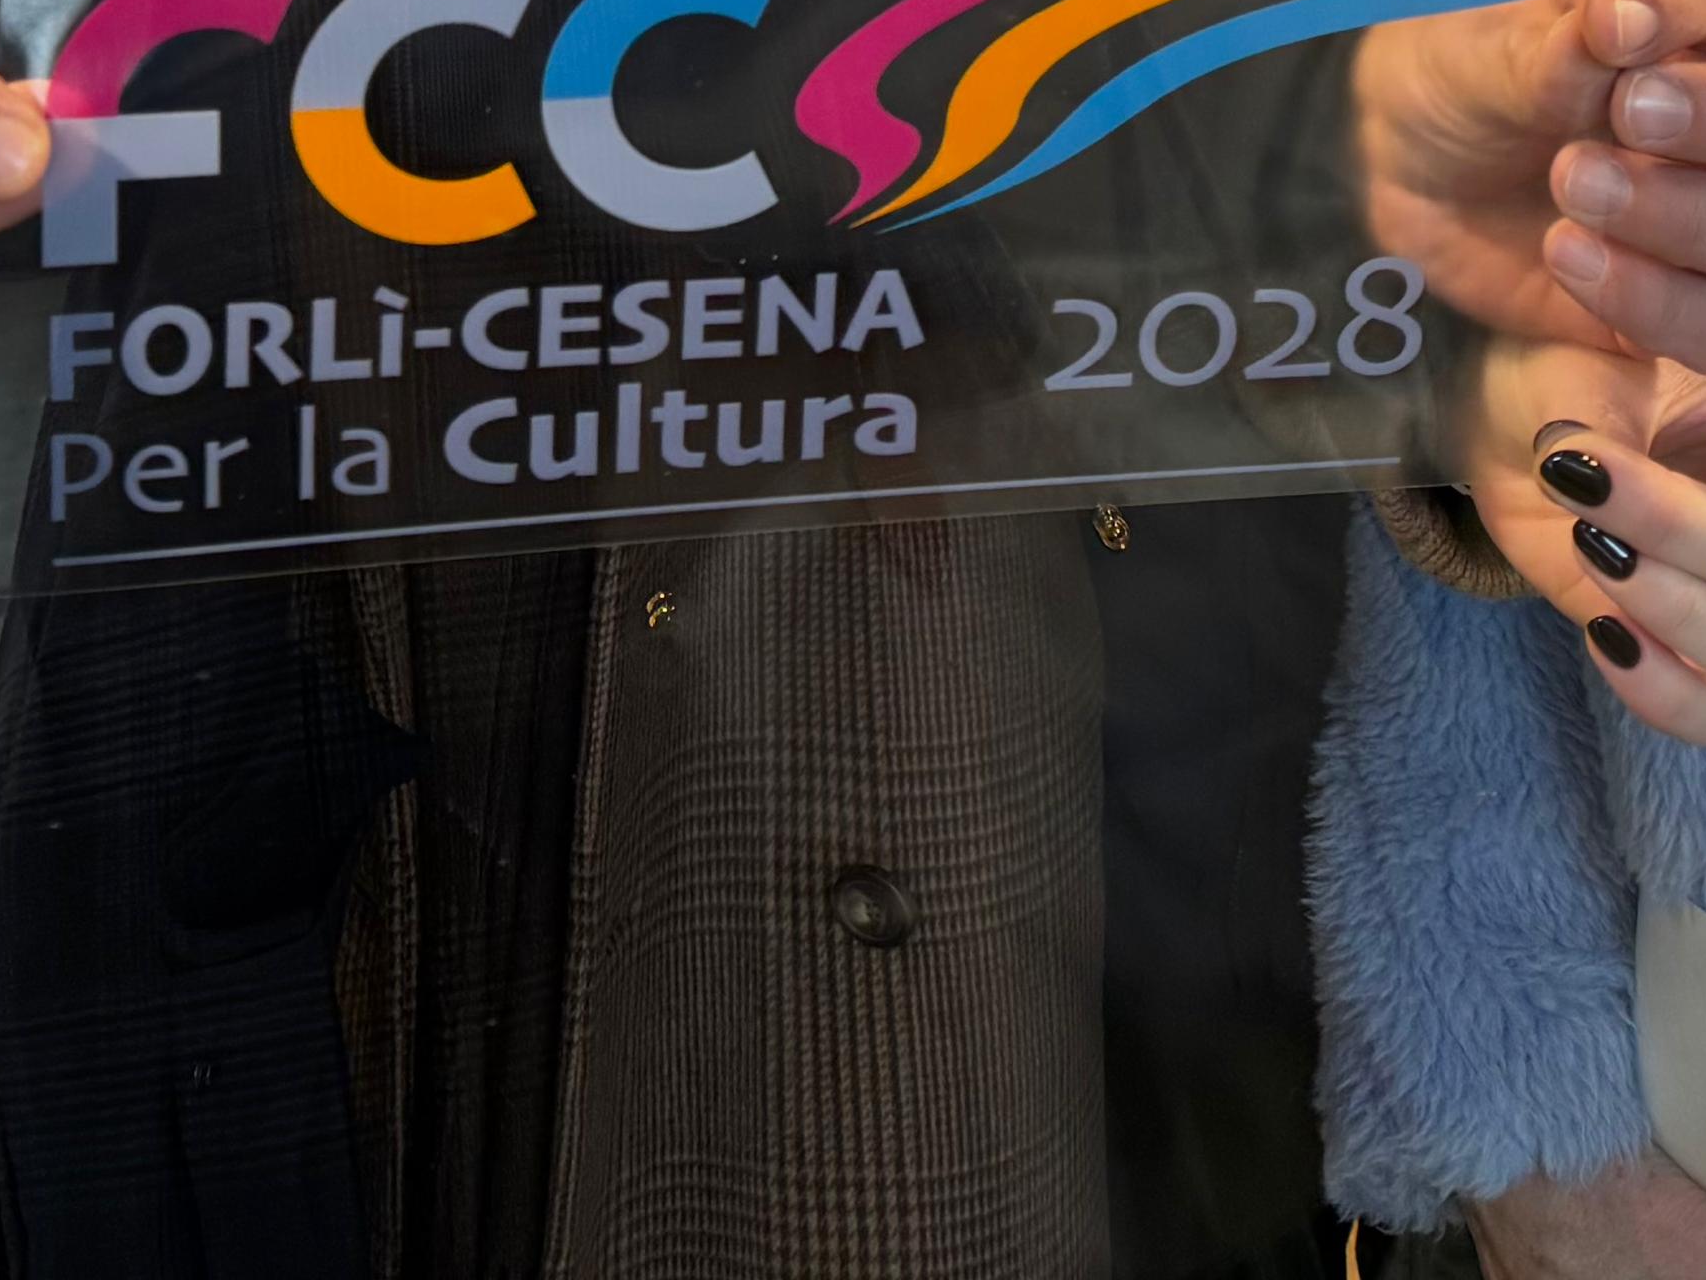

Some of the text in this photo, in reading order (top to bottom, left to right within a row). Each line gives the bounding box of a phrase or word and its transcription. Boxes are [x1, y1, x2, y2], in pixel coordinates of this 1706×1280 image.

[1043, 255, 1425, 392] 2028
[48, 381, 919, 522] Per la Cultura
